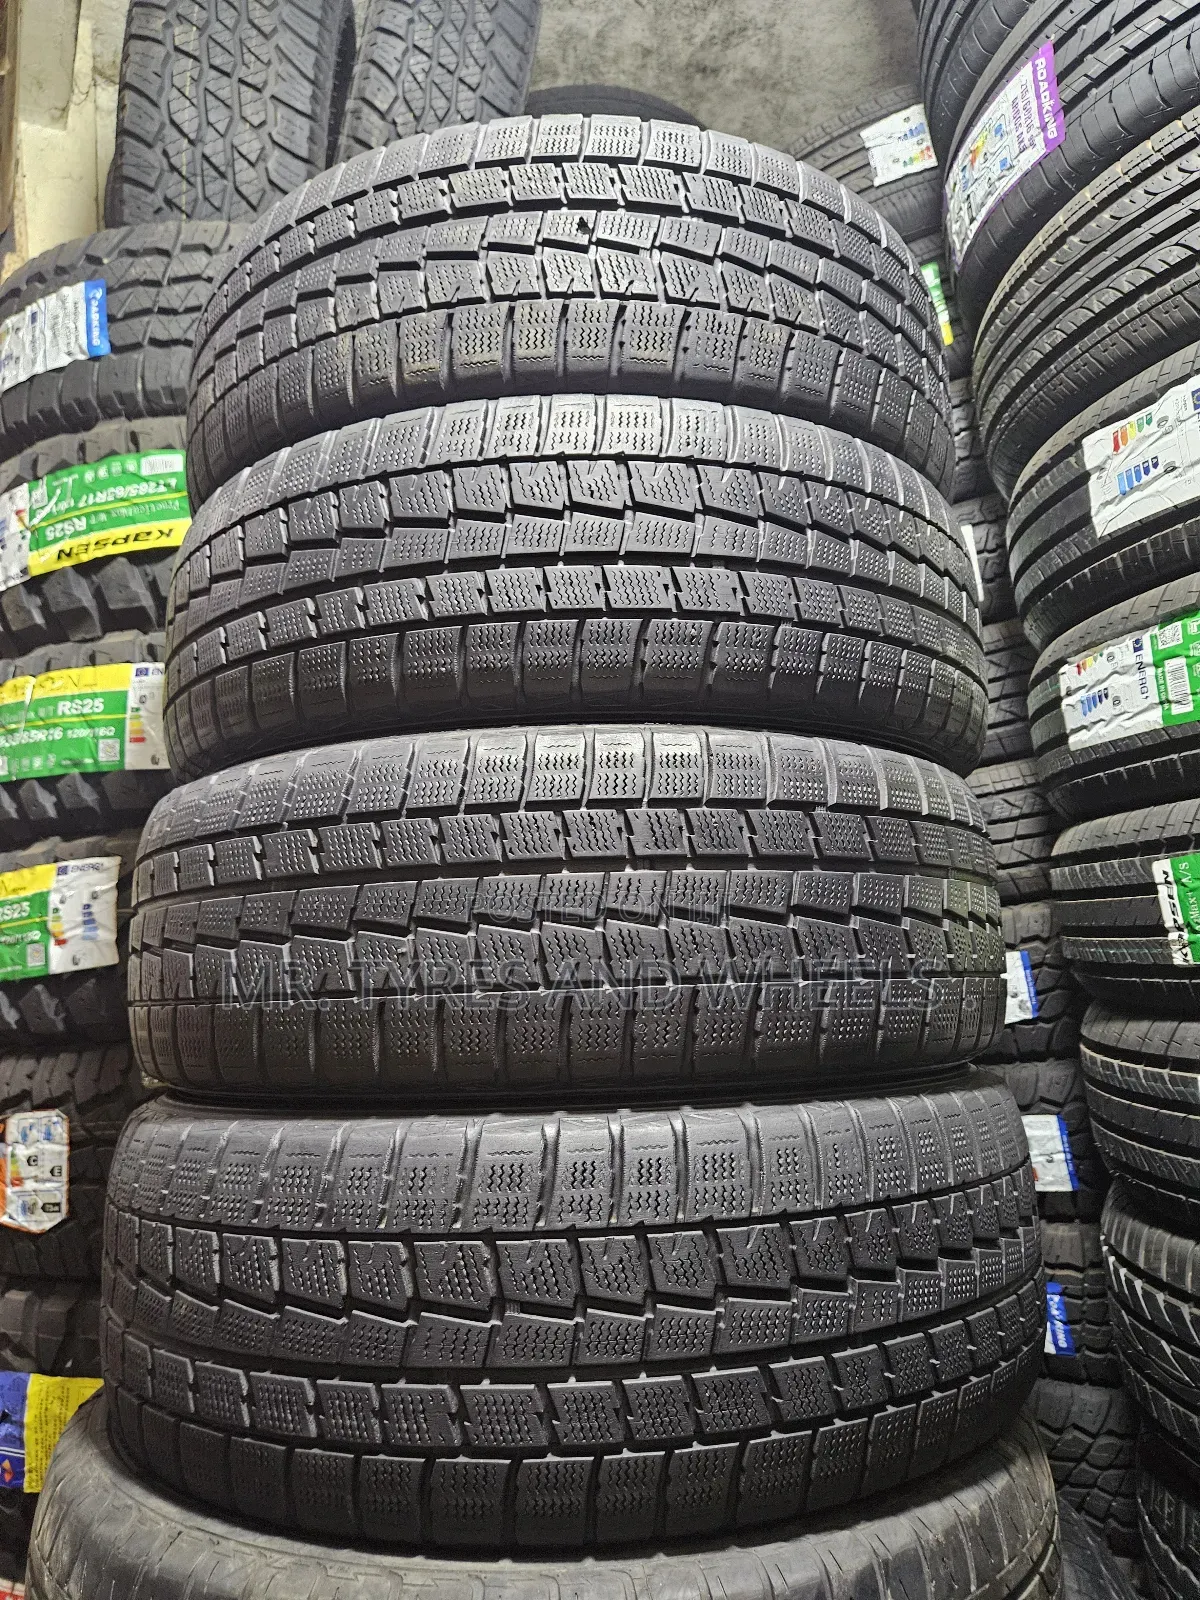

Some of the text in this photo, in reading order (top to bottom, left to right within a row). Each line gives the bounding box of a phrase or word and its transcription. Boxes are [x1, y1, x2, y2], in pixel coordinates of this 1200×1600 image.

[1034, 57, 1057, 139] ROADKING
[45, 517, 87, 540] RS25
[57, 698, 105, 717] RS25
